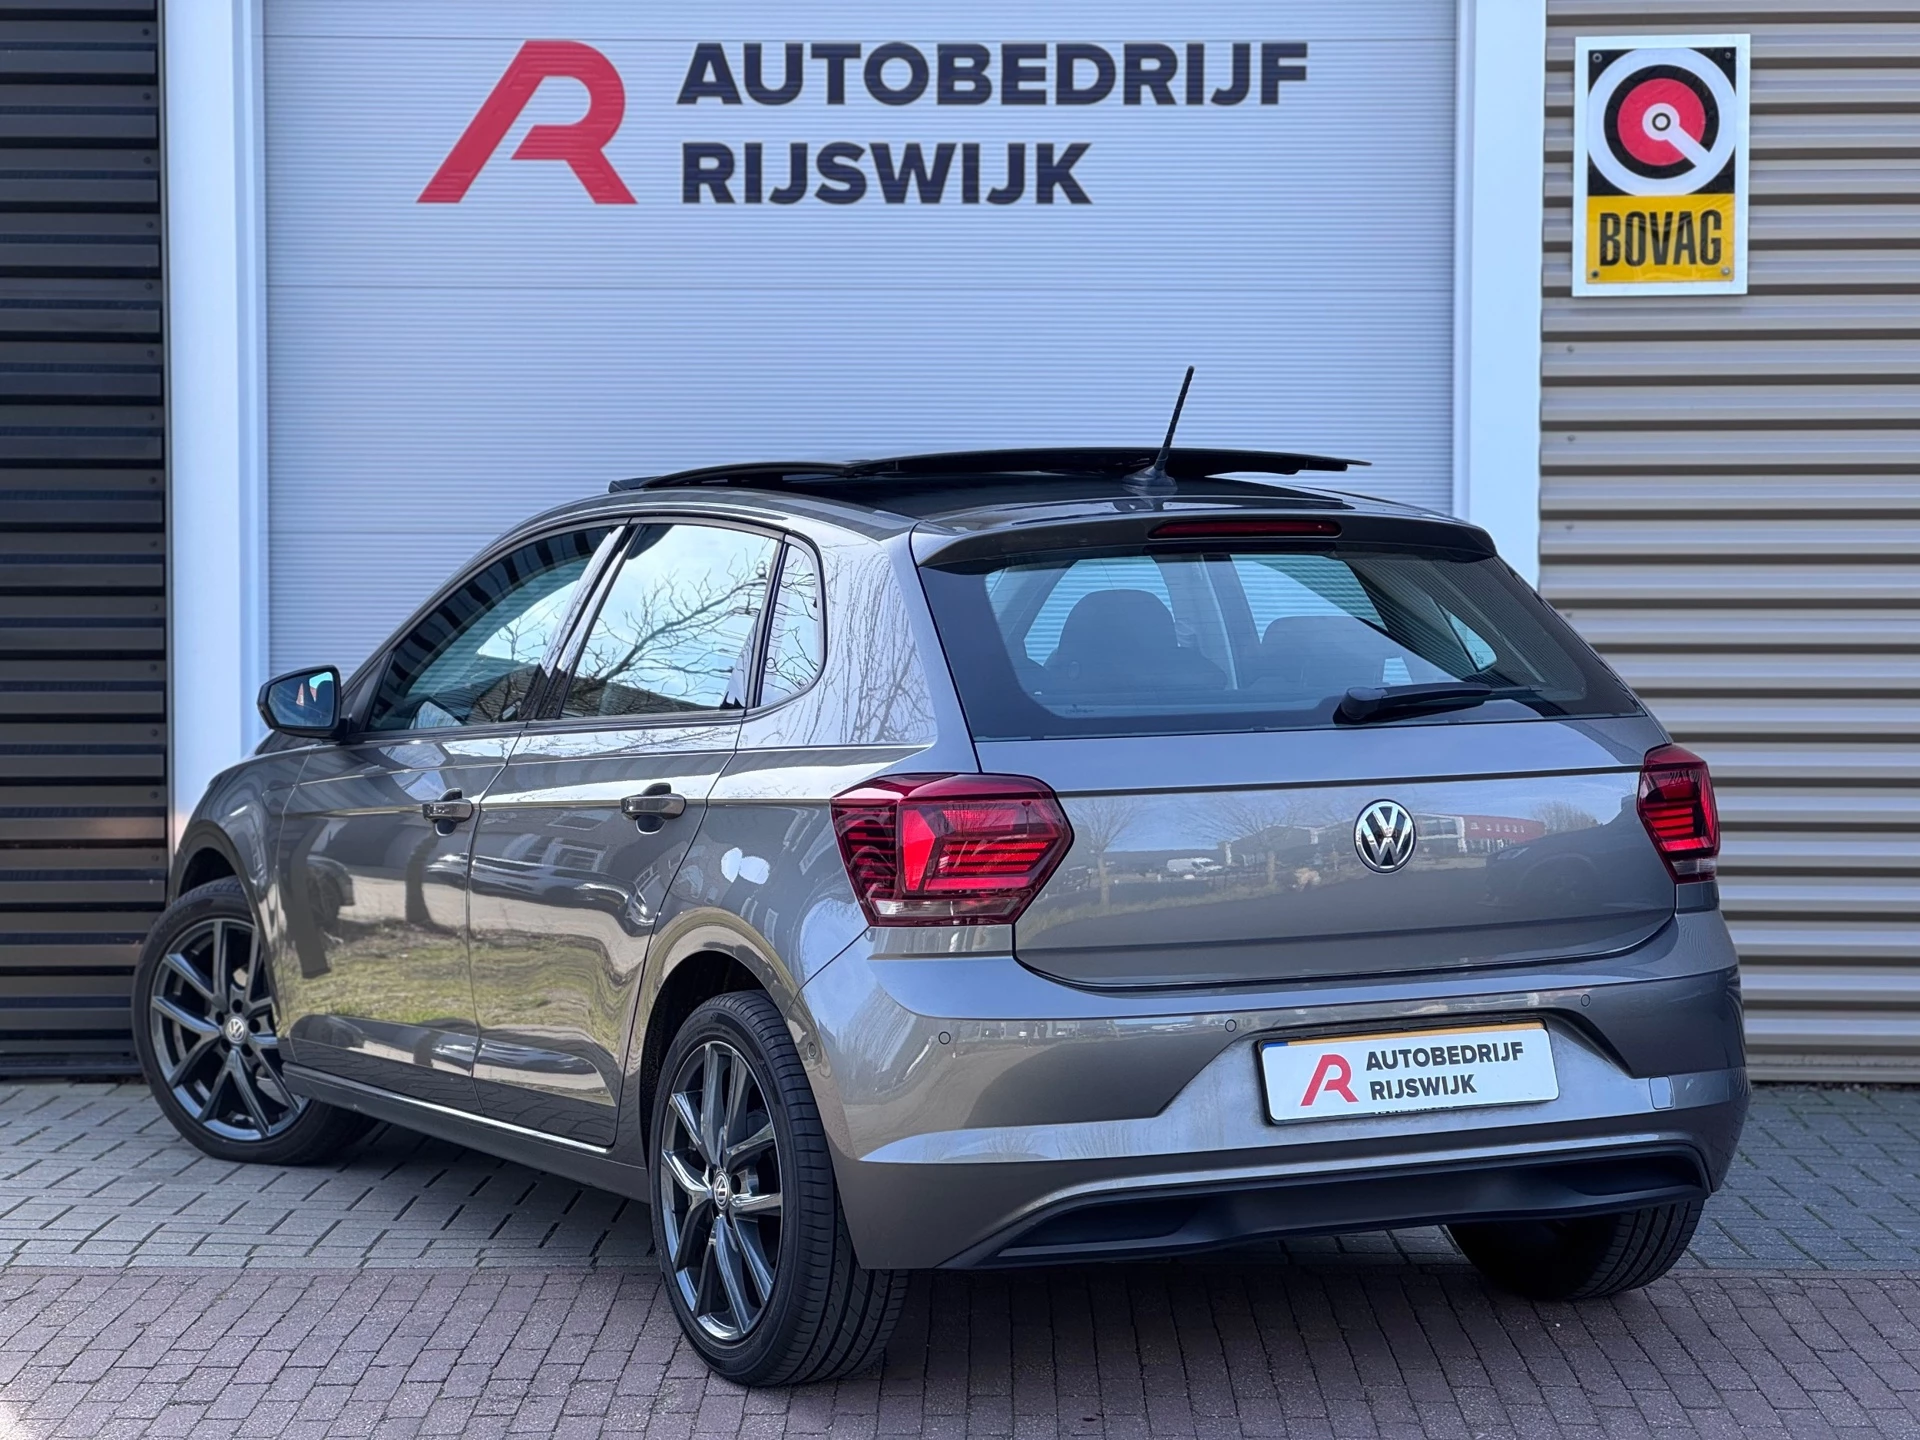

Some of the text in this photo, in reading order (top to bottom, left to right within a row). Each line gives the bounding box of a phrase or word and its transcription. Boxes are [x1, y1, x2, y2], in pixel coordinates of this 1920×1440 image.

[676, 41, 1308, 105] AUTOBEDRIJF
[682, 142, 1092, 205] RIJSWIJK
[1599, 209, 1722, 267] BOVAG
[1365, 1041, 1524, 1072] AUTOBEDRIJF
[1369, 1073, 1478, 1101] RIJSWIJK
